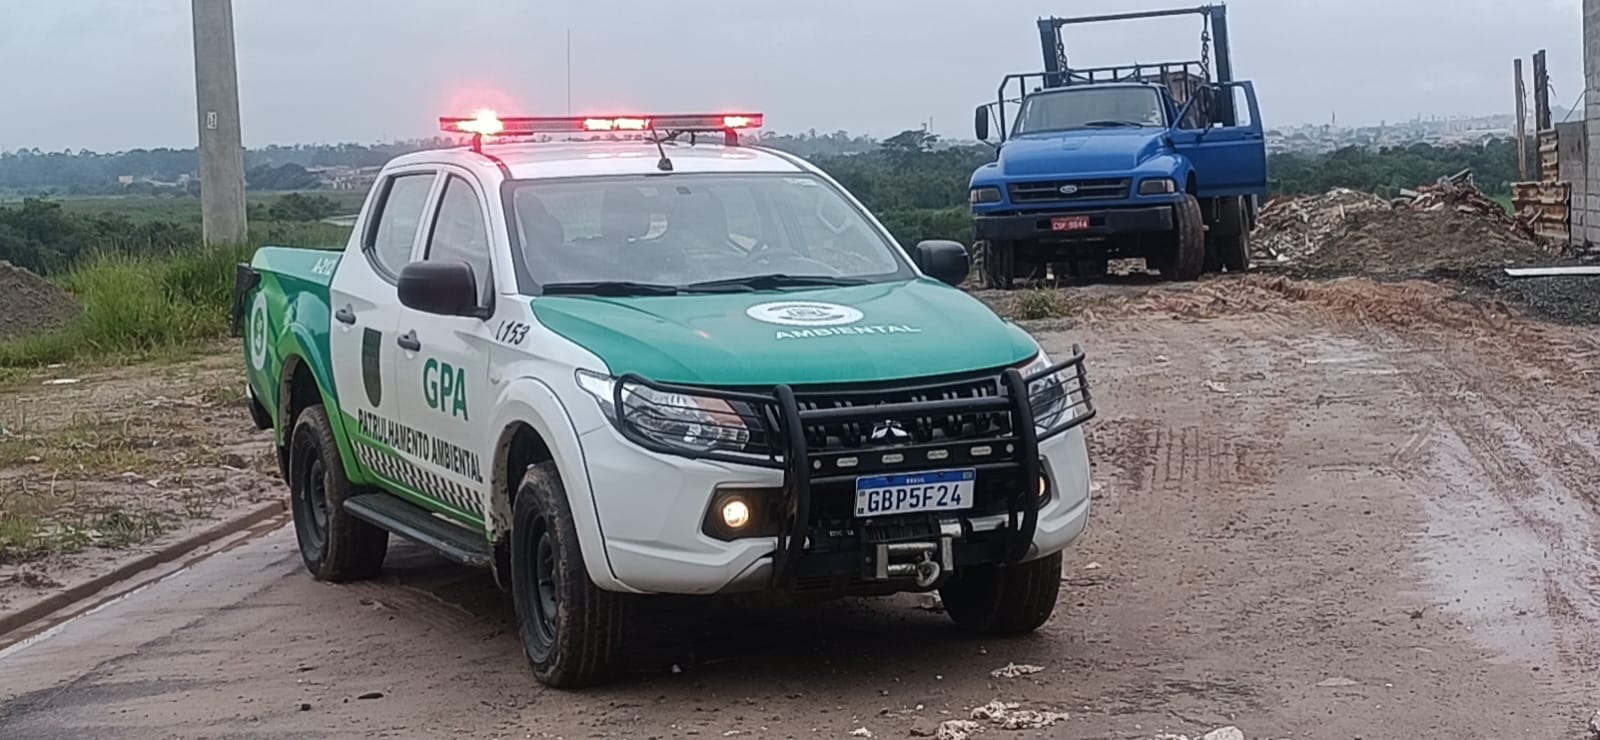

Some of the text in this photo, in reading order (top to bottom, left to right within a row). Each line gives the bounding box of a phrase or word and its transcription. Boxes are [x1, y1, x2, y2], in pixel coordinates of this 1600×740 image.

[501, 320, 530, 345] 153
[776, 324, 922, 340] AMBIENTAL
[423, 358, 468, 421] GPA
[358, 408, 483, 484] PATRULHAMENTO AMBIENTAL
[867, 484, 962, 513] GBP5F24
